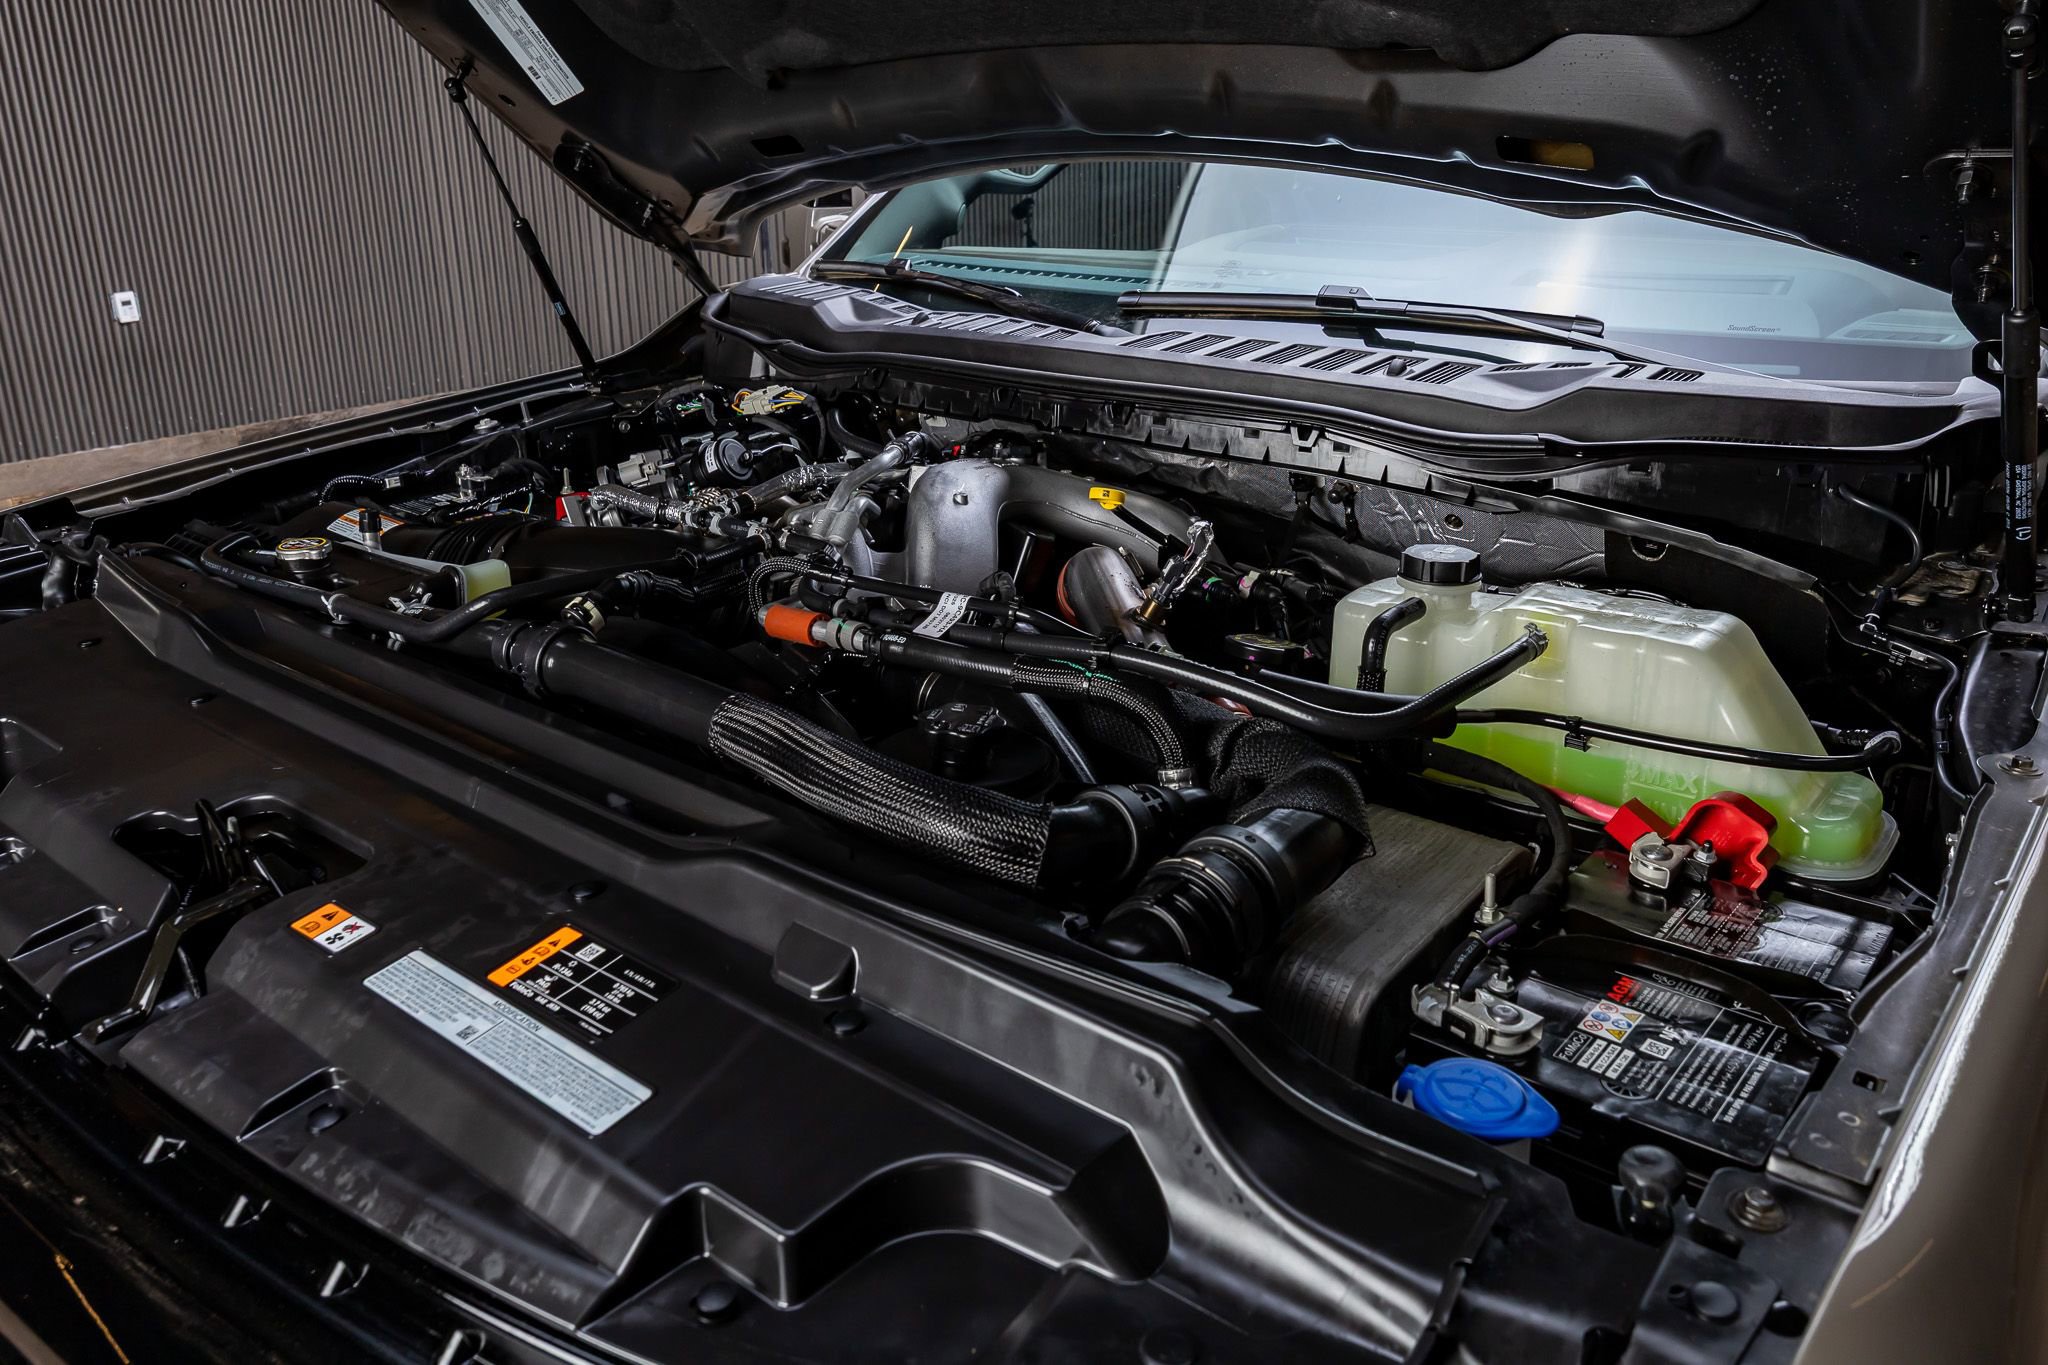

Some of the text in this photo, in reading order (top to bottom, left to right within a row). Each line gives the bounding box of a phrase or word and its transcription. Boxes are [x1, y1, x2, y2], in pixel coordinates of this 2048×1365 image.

[1727, 324, 1776, 333] SoundScreen
[550, 962, 576, 977] R-134a
[507, 981, 536, 998] FoMoCo
[533, 995, 549, 1005] SAE
[534, 977, 552, 988] PAG
[1604, 974, 1636, 1002] AGM
[489, 999, 544, 1033] MODIFICATION
[1557, 1031, 1588, 1061] FoMoCo
